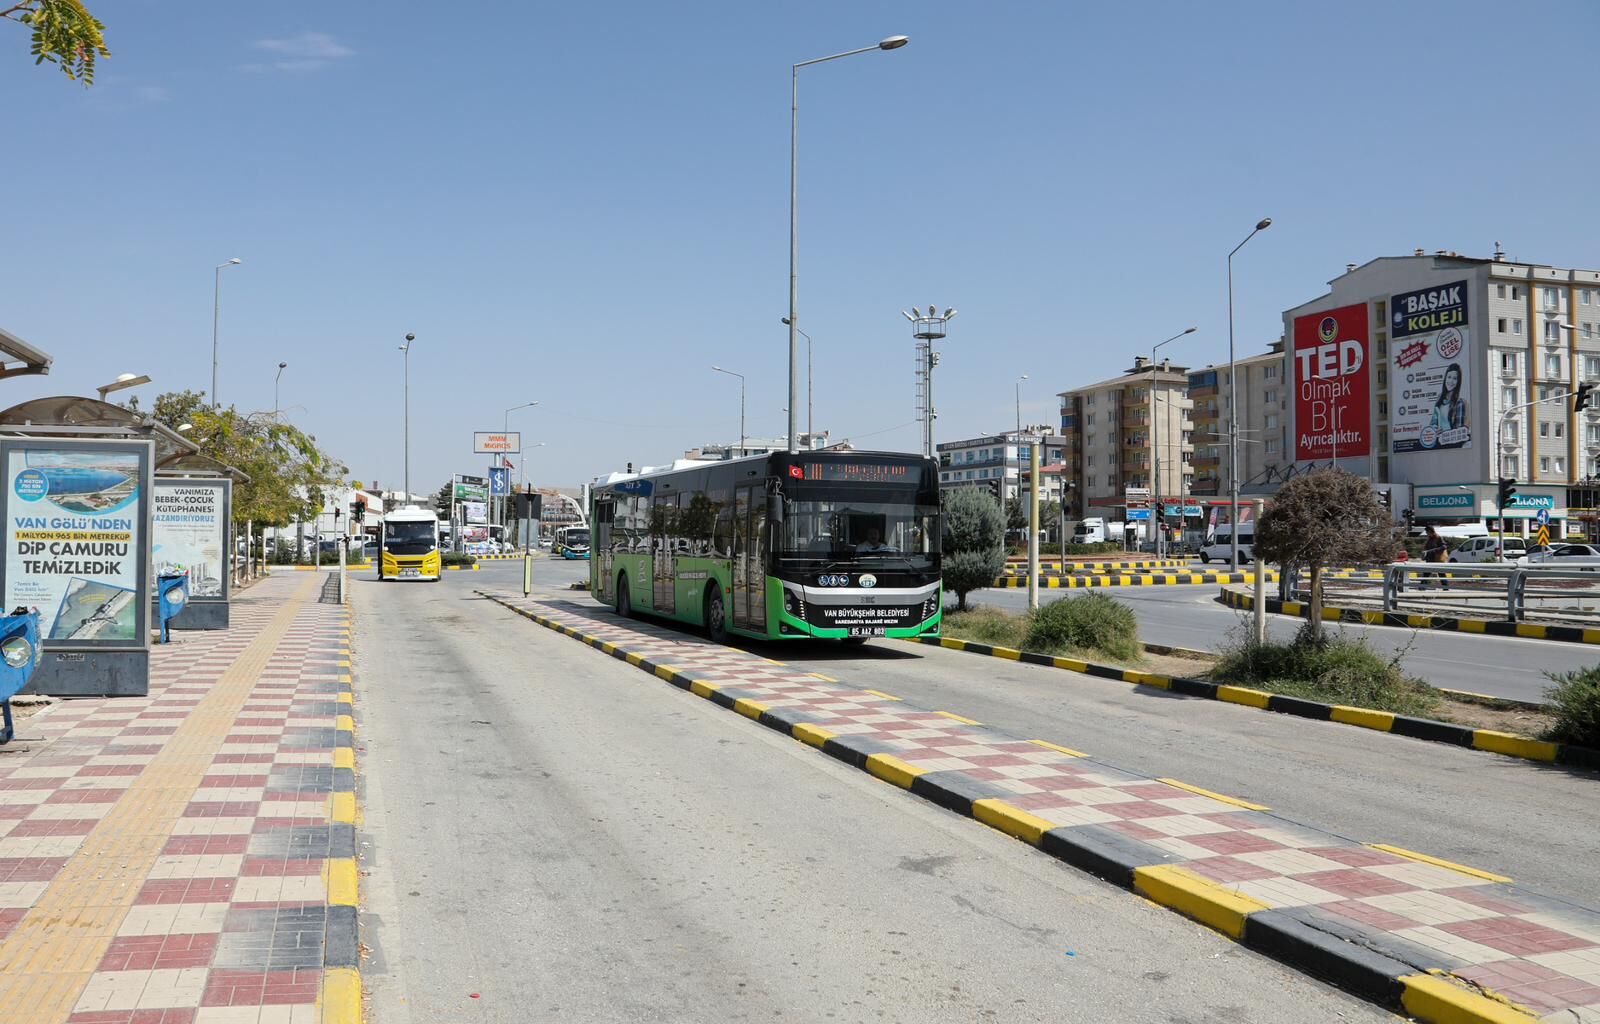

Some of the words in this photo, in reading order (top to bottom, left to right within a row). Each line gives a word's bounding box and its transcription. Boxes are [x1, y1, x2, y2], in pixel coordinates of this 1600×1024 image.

[1407, 286, 1461, 313] BAŞAK
[1295, 339, 1364, 382] TED
[1302, 376, 1351, 401] Olmak
[1312, 400, 1348, 431] Bir
[1300, 429, 1362, 450] Ayrıcalıktır.
[174, 488, 215, 496] VANIMIZA
[154, 495, 215, 506] BEBEK-ÇOCUK
[1423, 496, 1469, 506] BELLONA
[15, 517, 47, 529] VAN
[90, 533, 131, 541] METREKÜP
[49, 542, 128, 559] ÇAMURU
[824, 609, 837, 617] VAN
[838, 607, 876, 618] BÜYÜKŞEHİR
[877, 607, 910, 617] BELEDİYESİ
